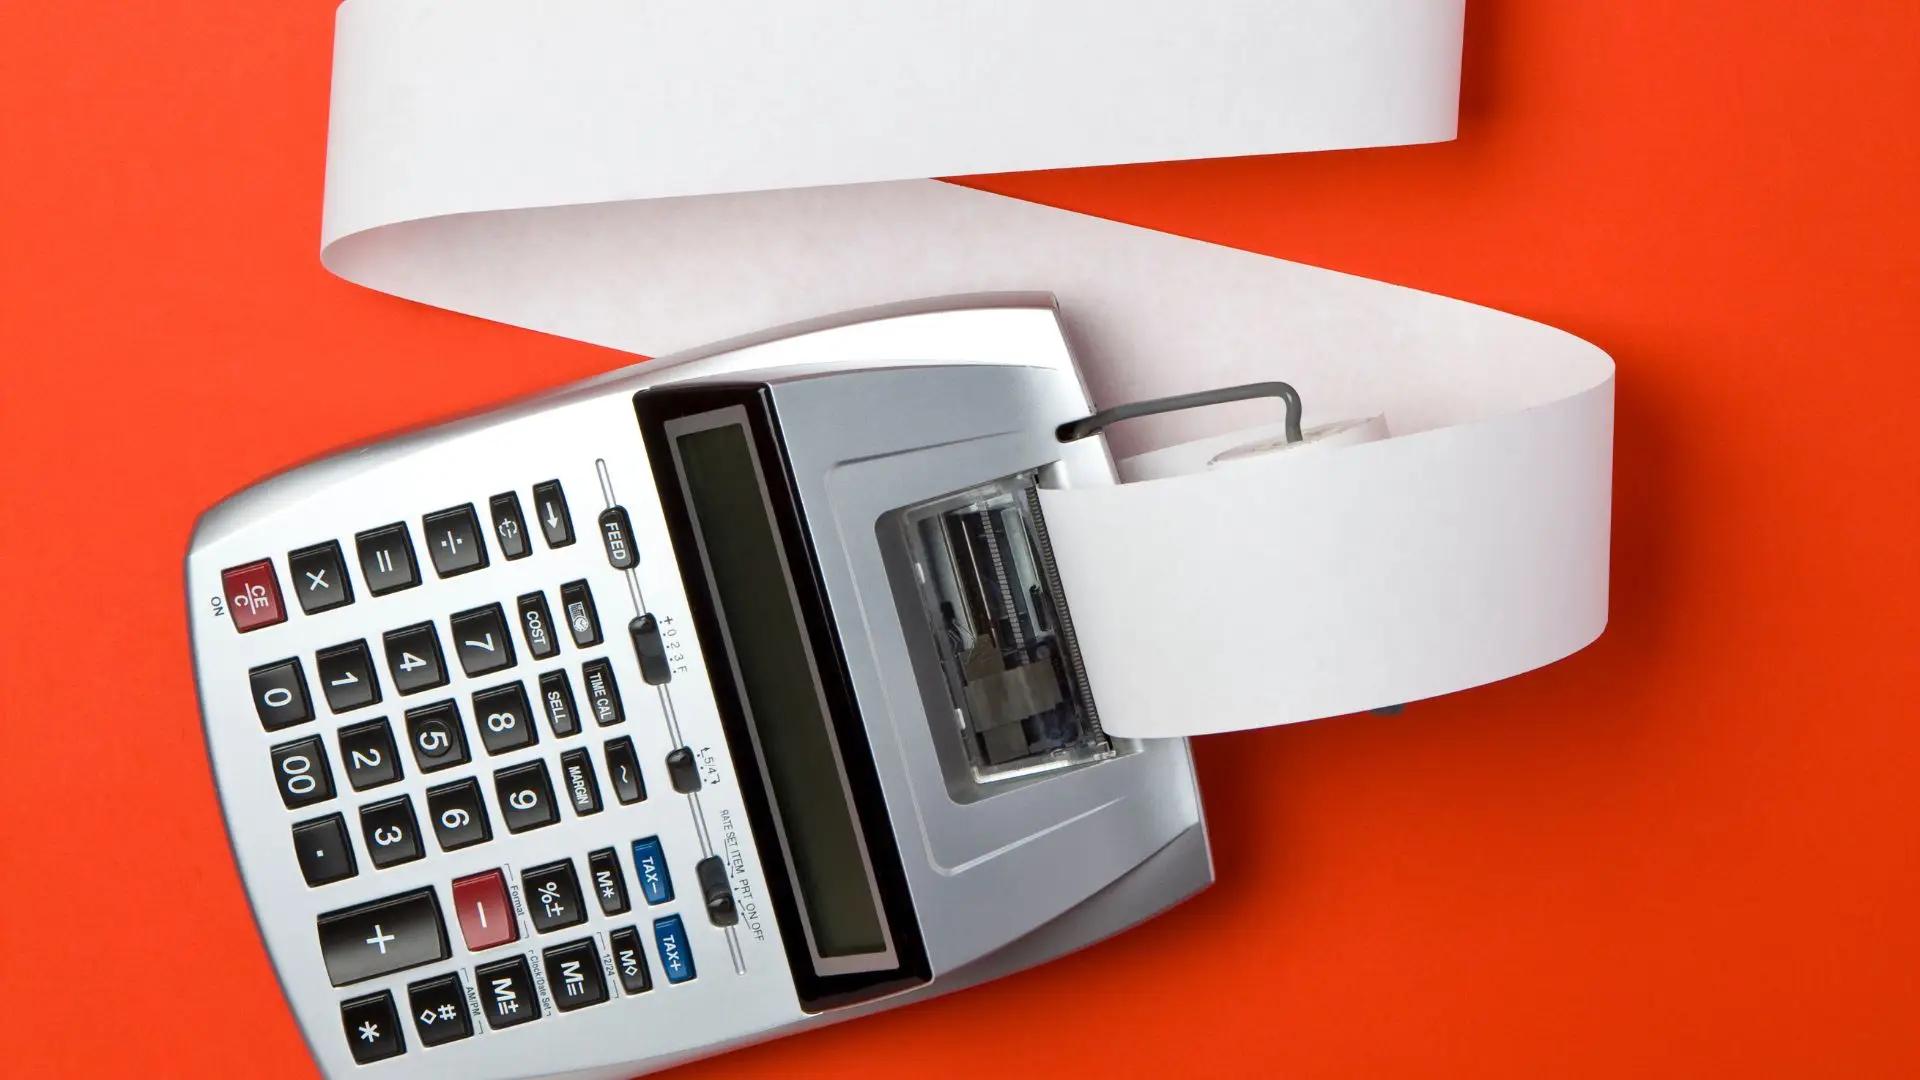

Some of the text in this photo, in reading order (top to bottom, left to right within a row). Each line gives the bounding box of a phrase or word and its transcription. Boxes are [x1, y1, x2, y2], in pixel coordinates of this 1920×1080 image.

[605, 522, 626, 560] FEED
[210, 596, 224, 617] ON
[234, 594, 248, 607] C
[251, 585, 269, 608] CE
[526, 610, 546, 645] COST
[465, 633, 495, 652] 7
[671, 641, 680, 649] 2
[400, 652, 427, 672] 4
[674, 654, 684, 662] 3
[331, 671, 359, 686] 1
[264, 687, 292, 707] 0
[589, 672, 613, 720] TIME CAL
[547, 691, 566, 723] SELL
[487, 712, 515, 732] 8
[419, 731, 448, 750] 5
[351, 748, 381, 769] 2
[282, 755, 316, 794] 00
[568, 765, 589, 805] MARGIN
[509, 789, 538, 809] 9
[441, 808, 469, 828] 6
[374, 825, 402, 846] 3
[720, 809, 765, 942] RATE SET ITEM PRT ON OFF
[510, 885, 525, 916] Format
[663, 933, 681, 972] TAX+
[602, 953, 615, 976] 12/24
[530, 955, 551, 1012] Clock/Date Set
[466, 986, 481, 1016] AM/PM
